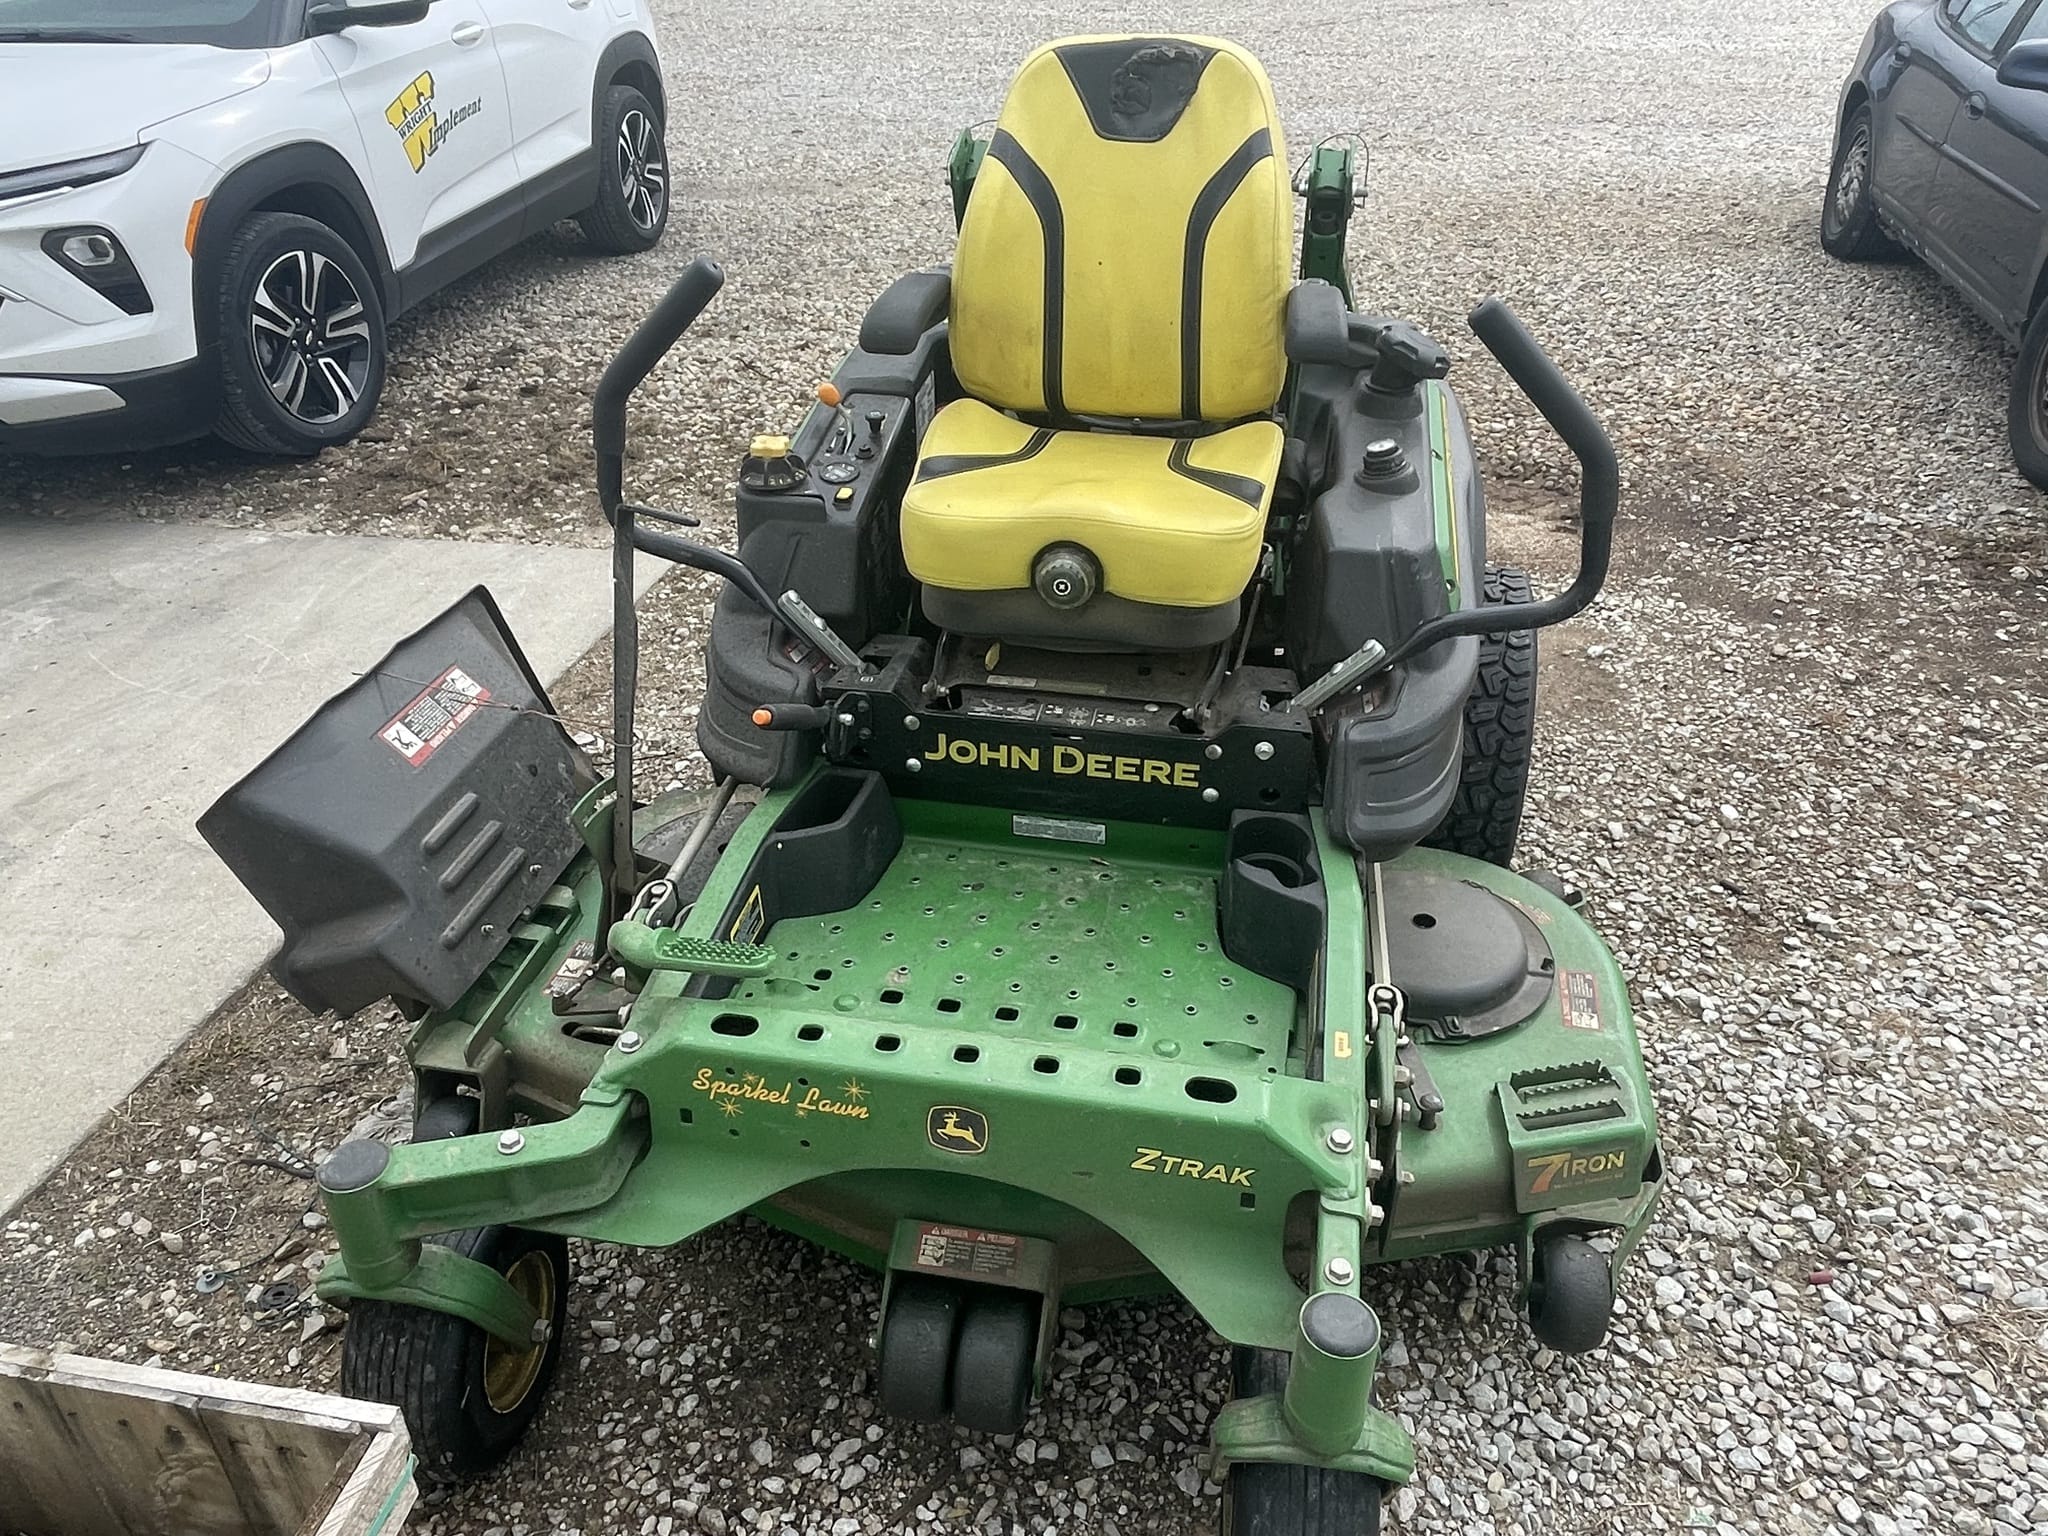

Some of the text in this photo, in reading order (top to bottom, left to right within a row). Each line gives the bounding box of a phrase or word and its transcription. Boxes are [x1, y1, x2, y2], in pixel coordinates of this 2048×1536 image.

[398, 96, 482, 157] WRIGHT Implement
[924, 733, 1201, 788] JOHN DEERE
[692, 1067, 869, 1120] Sparkel Lawn
[1129, 1146, 1257, 1188] ZTRAK
